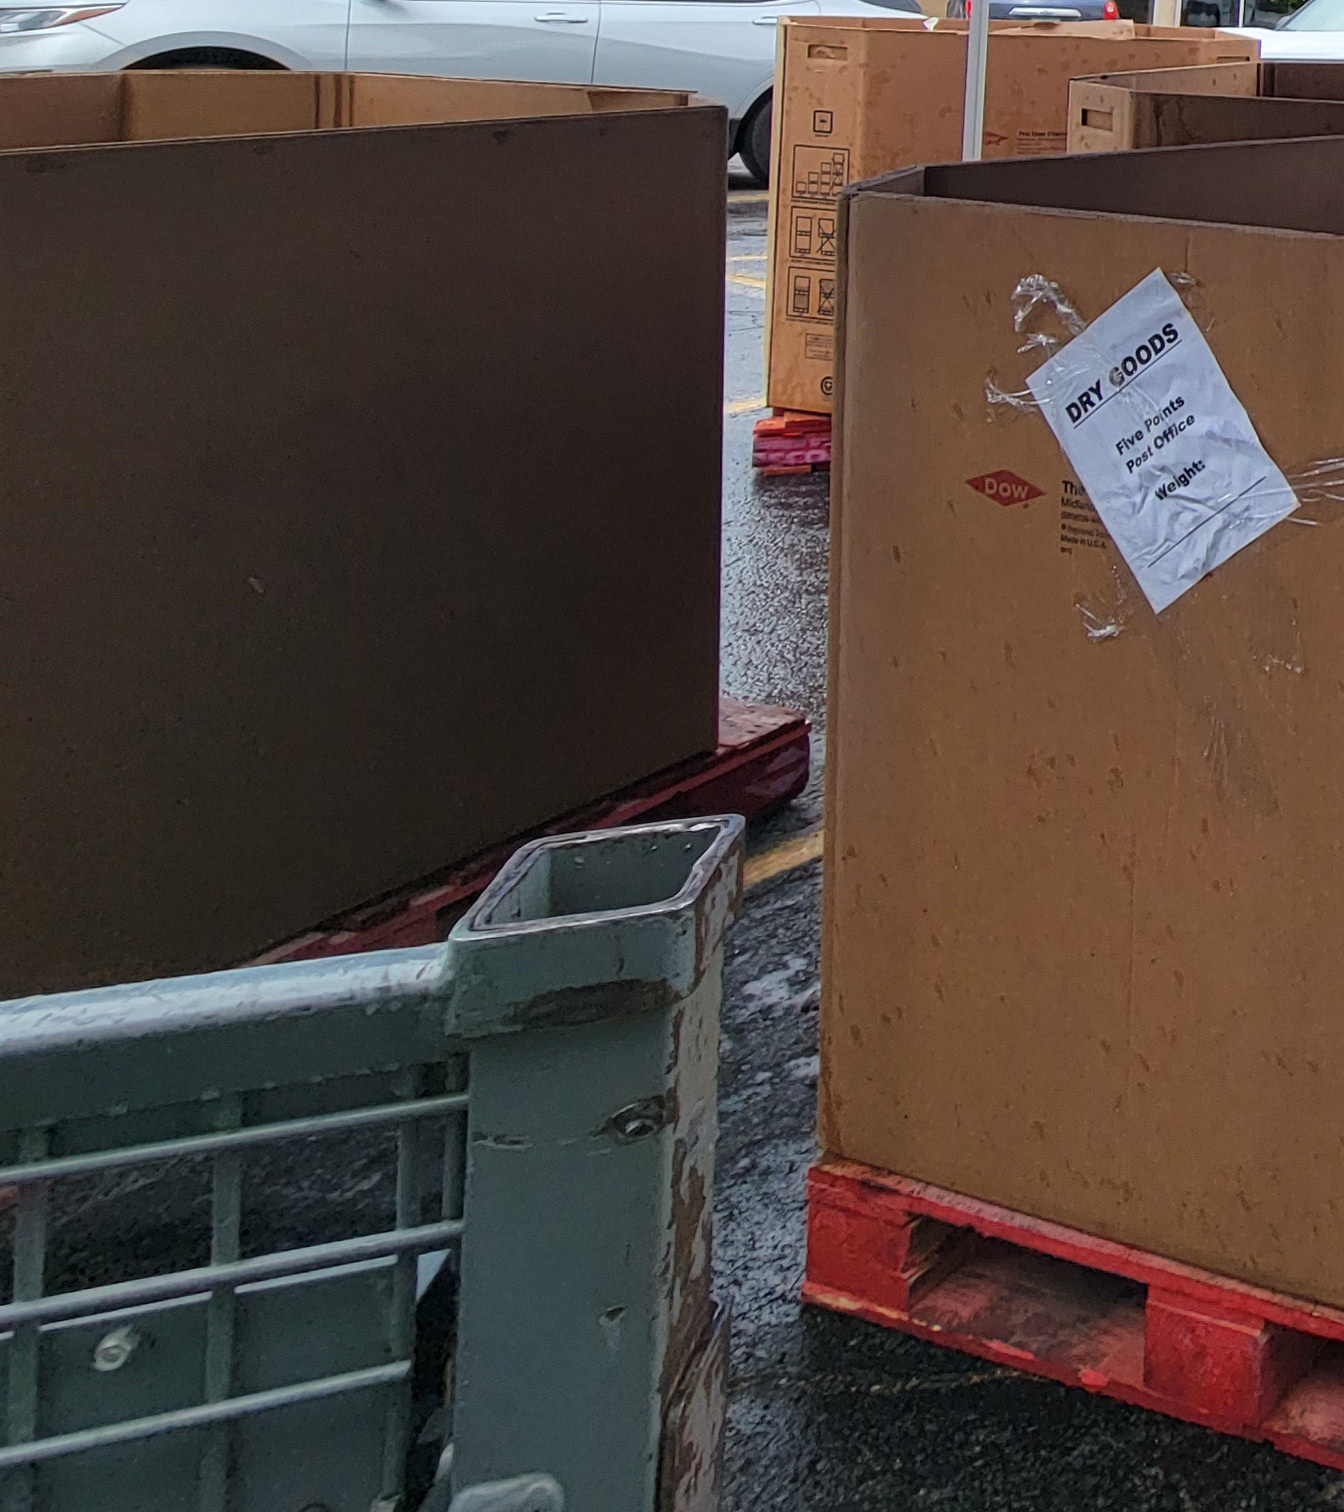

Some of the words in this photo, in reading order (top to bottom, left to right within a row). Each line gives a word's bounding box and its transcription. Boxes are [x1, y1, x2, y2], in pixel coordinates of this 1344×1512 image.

[1065, 378, 1104, 424] DRY
[1109, 322, 1179, 388] GOODS
[1115, 429, 1144, 456] Five
[1144, 396, 1185, 433] Points
[1126, 445, 1154, 475] Post
[1153, 414, 1195, 450] Office
[984, 477, 1029, 499] DOW
[1155, 459, 1206, 500] Weight:
